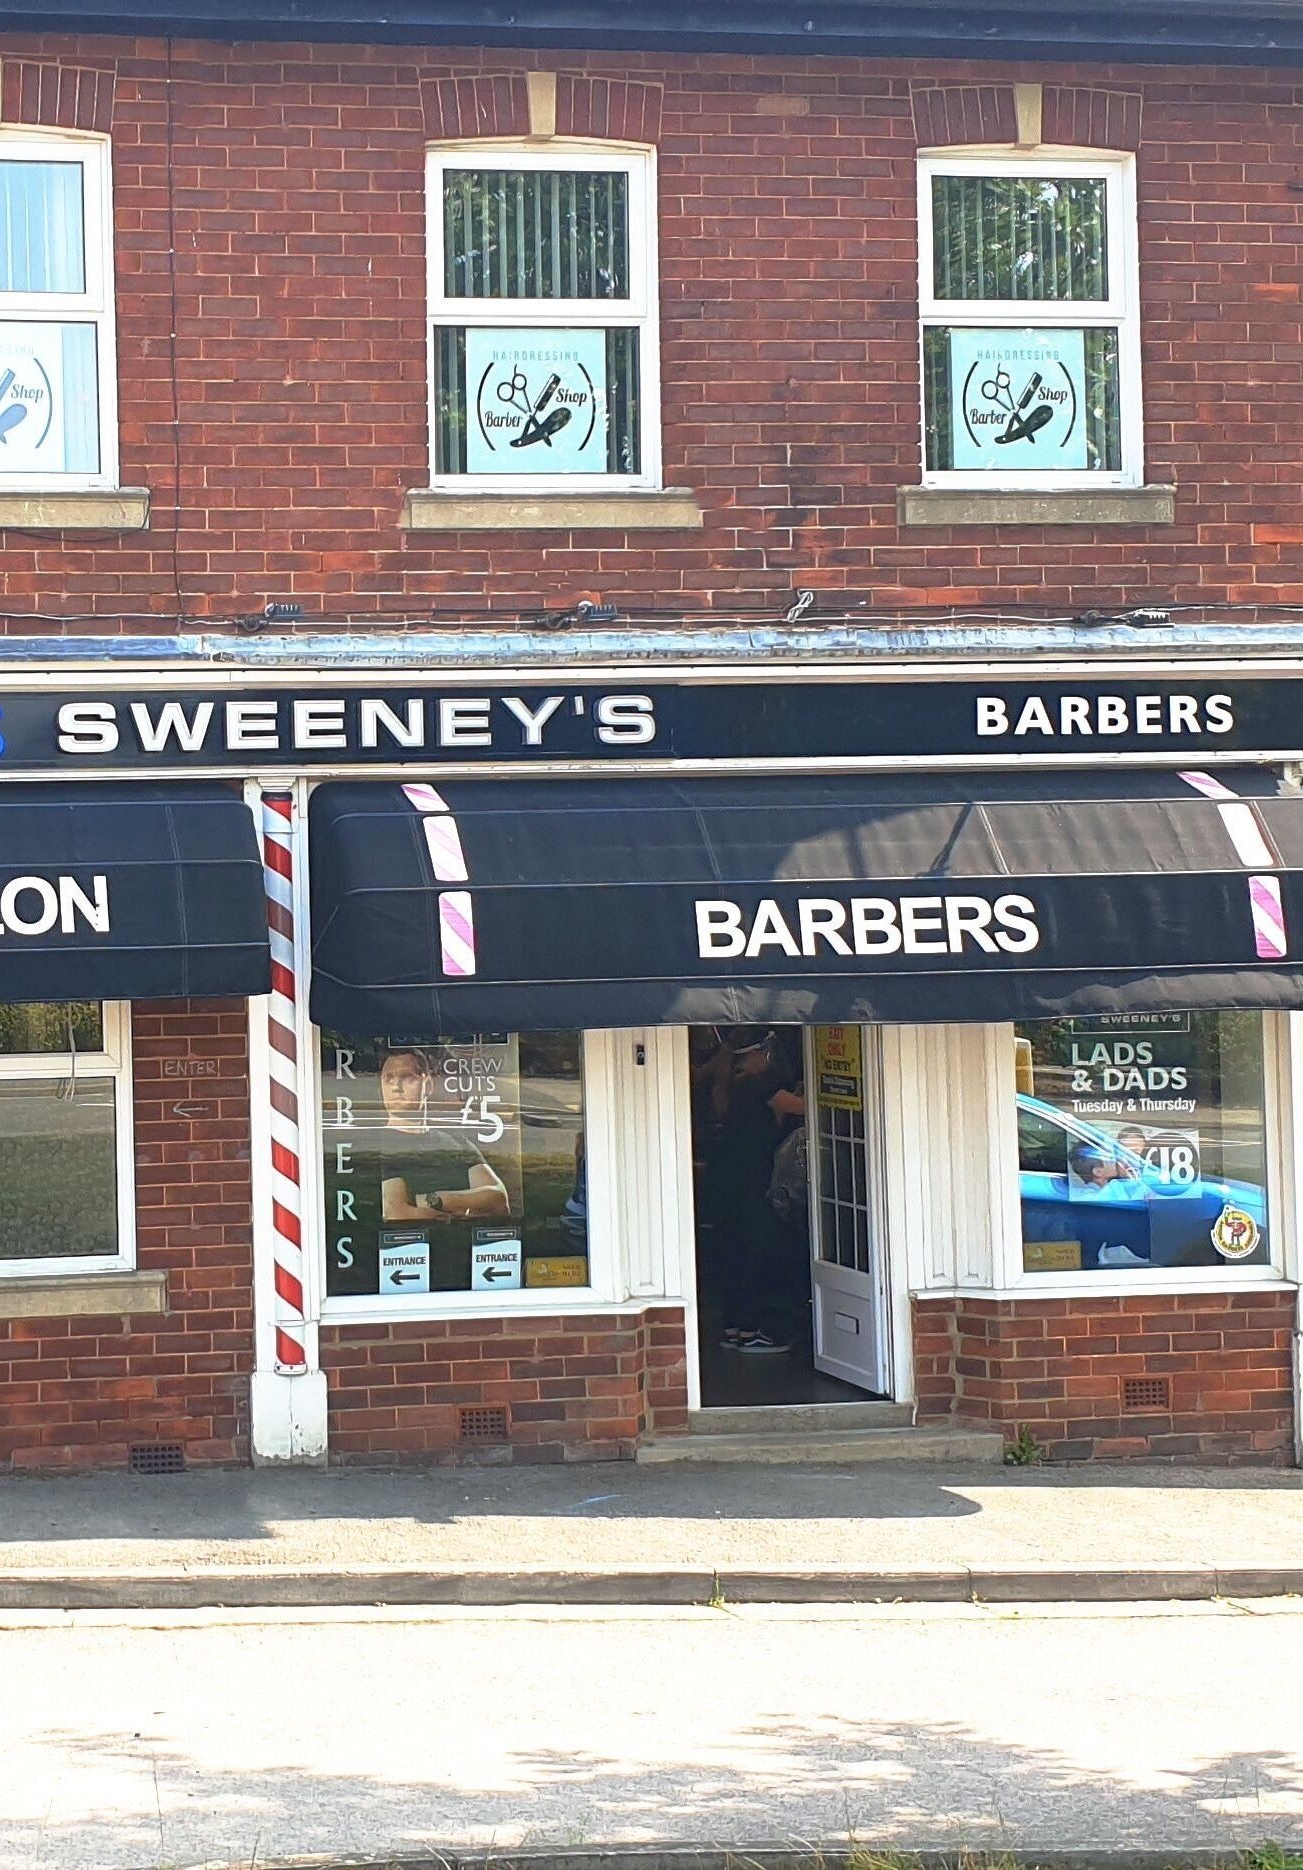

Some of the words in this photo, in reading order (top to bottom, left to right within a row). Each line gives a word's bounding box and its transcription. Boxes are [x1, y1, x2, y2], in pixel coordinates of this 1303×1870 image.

[10, 383, 44, 403] Shop
[485, 410, 523, 428] Barber
[555, 388, 588, 407] Shop
[970, 408, 1007, 425] Barber
[1037, 386, 1068, 404] Shop
[57, 694, 656, 754] SWEENEY'S
[976, 694, 1234, 736] BARBERS
[695, 894, 1040, 958] BARBERS
[1099, 1013, 1181, 1024] SWEENEY'S
[1071, 1041, 1153, 1066] LADS
[165, 1060, 217, 1076] ENTER
[443, 1057, 504, 1075] CREW
[444, 1075, 496, 1093] CUTS
[1071, 1068, 1093, 1093] &
[1102, 1066, 1188, 1092] DADS
[1072, 1098, 1124, 1115] Tuesday
[1126, 1099, 1137, 1112] &
[1138, 1097, 1197, 1113] Thursday
[460, 1095, 505, 1143] £5
[383, 1256, 427, 1266] ENTRANCE
[475, 1253, 518, 1263] ENTRANCE
